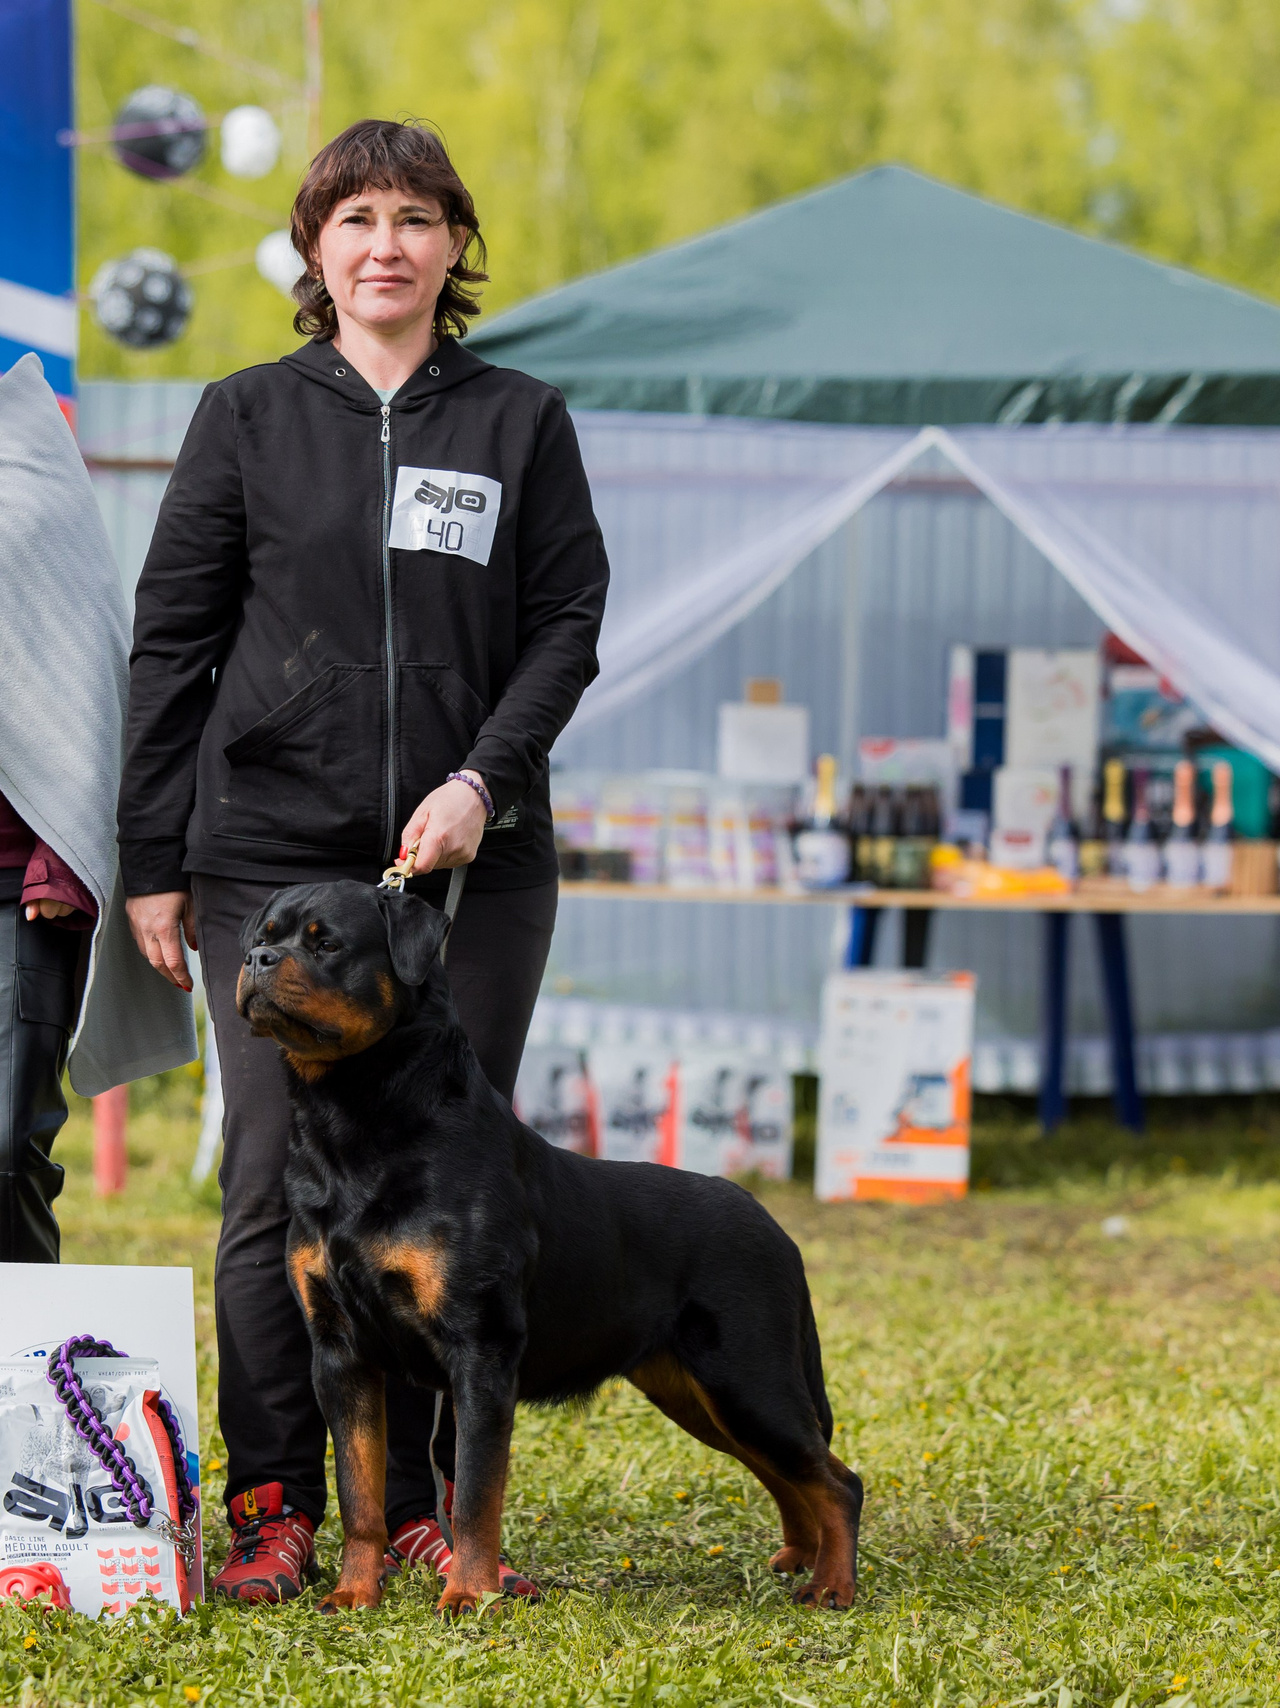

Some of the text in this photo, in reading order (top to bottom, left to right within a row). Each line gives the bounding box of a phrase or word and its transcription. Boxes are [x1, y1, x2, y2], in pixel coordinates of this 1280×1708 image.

[427, 519, 464, 551] 40
[5, 1543, 89, 1553] MEDIUM ADULT
